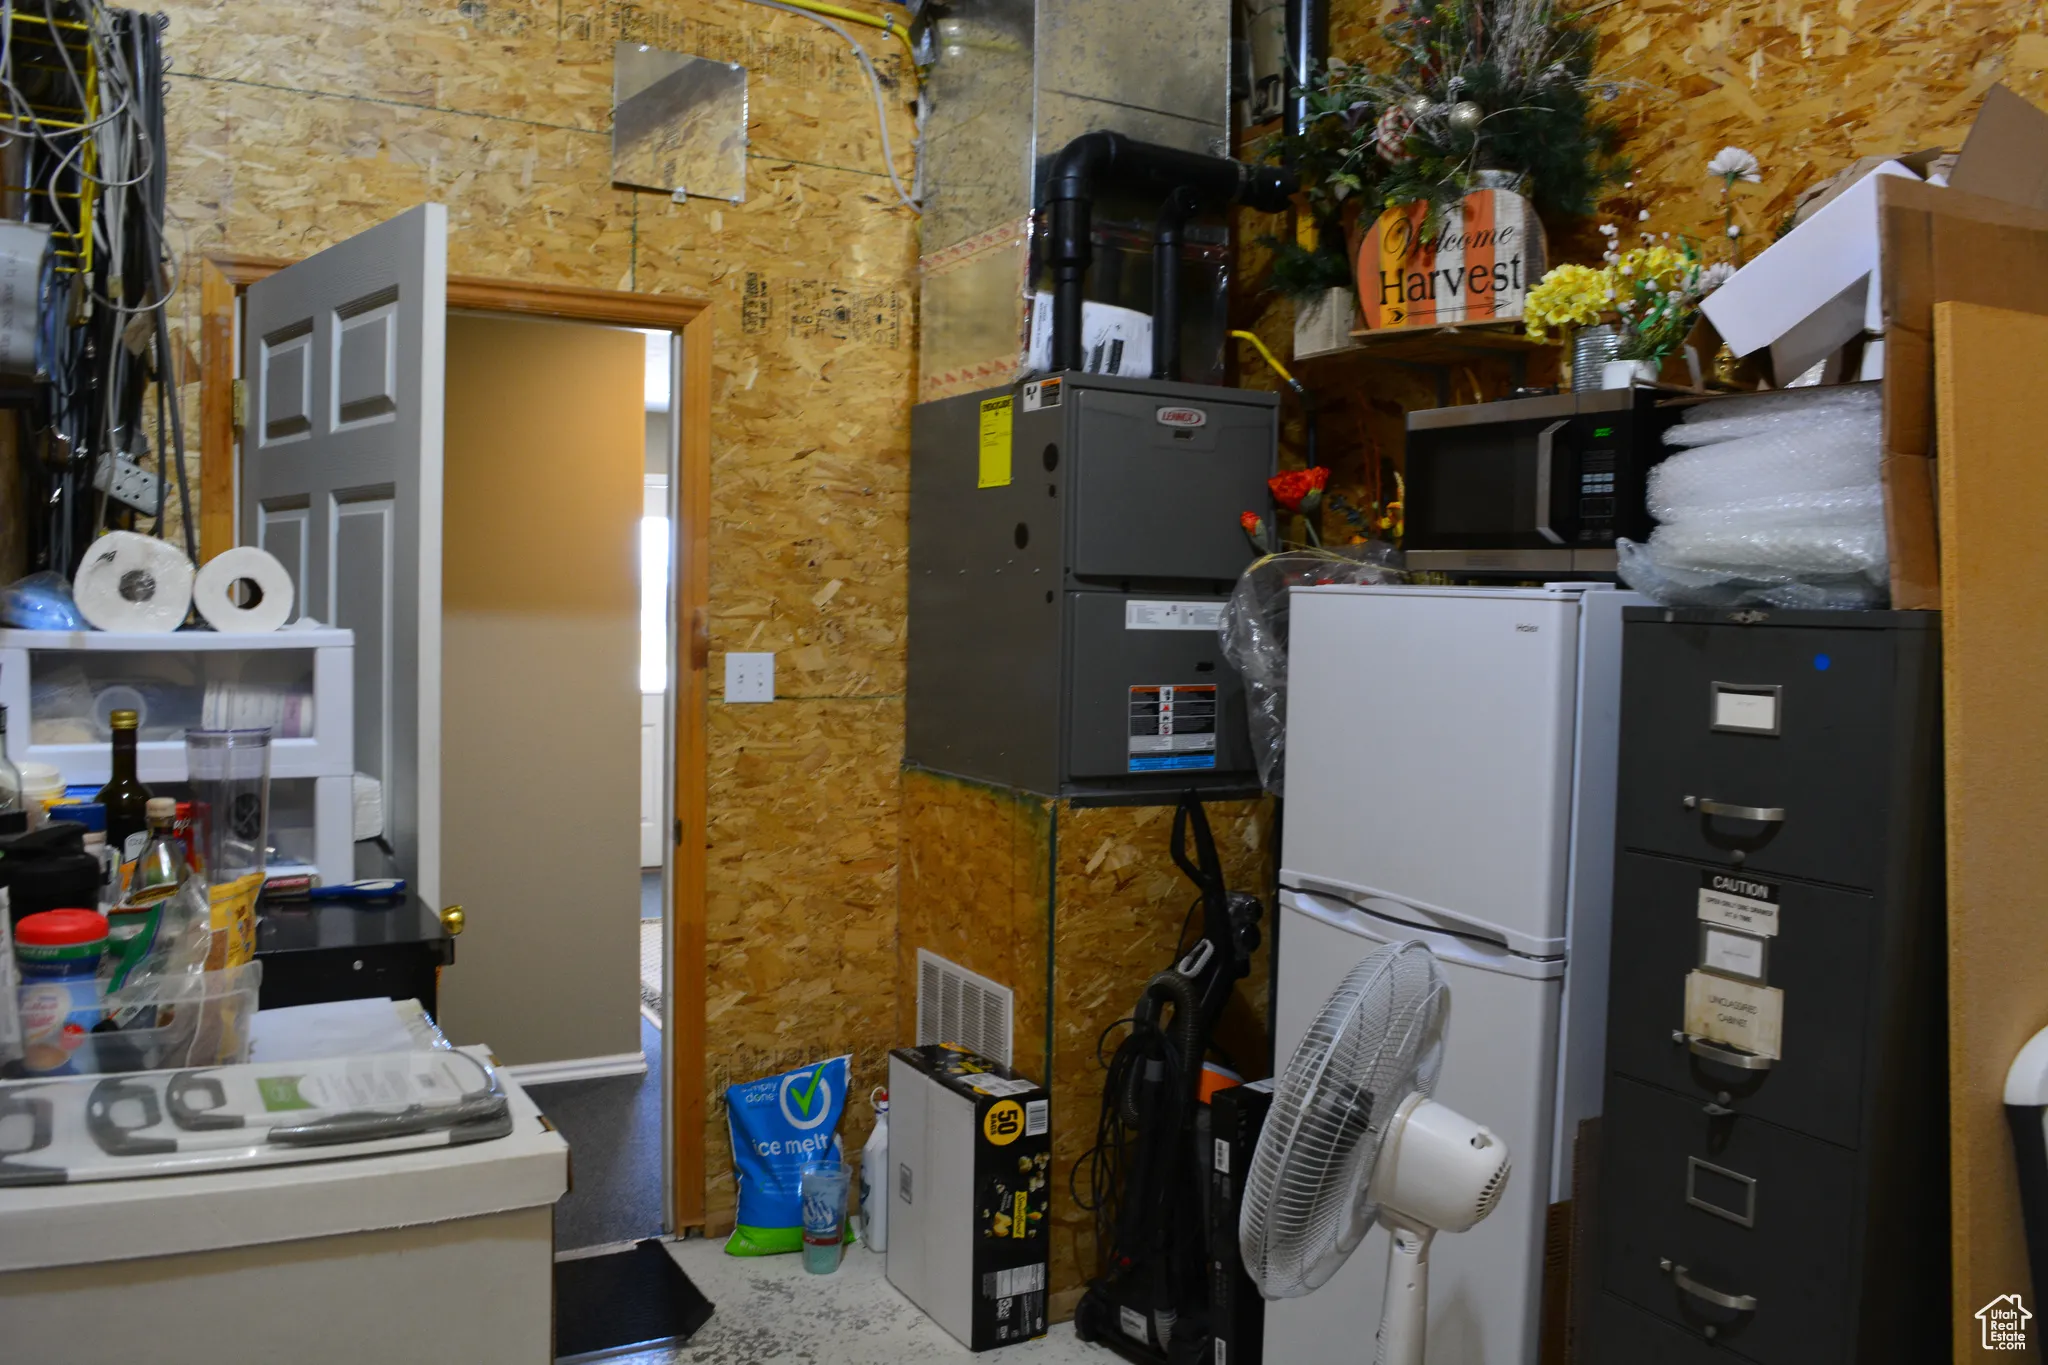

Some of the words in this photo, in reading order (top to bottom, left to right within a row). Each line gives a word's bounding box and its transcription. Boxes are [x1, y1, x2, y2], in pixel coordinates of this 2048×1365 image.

[1384, 206, 1514, 261] Welcome
[1380, 252, 1522, 305] Harvest
[1712, 875, 1769, 899] CAUTION
[745, 1092, 775, 1104] done
[997, 1109, 1018, 1135] 50
[752, 1138, 782, 1157] ice
[785, 1133, 829, 1155] melt
